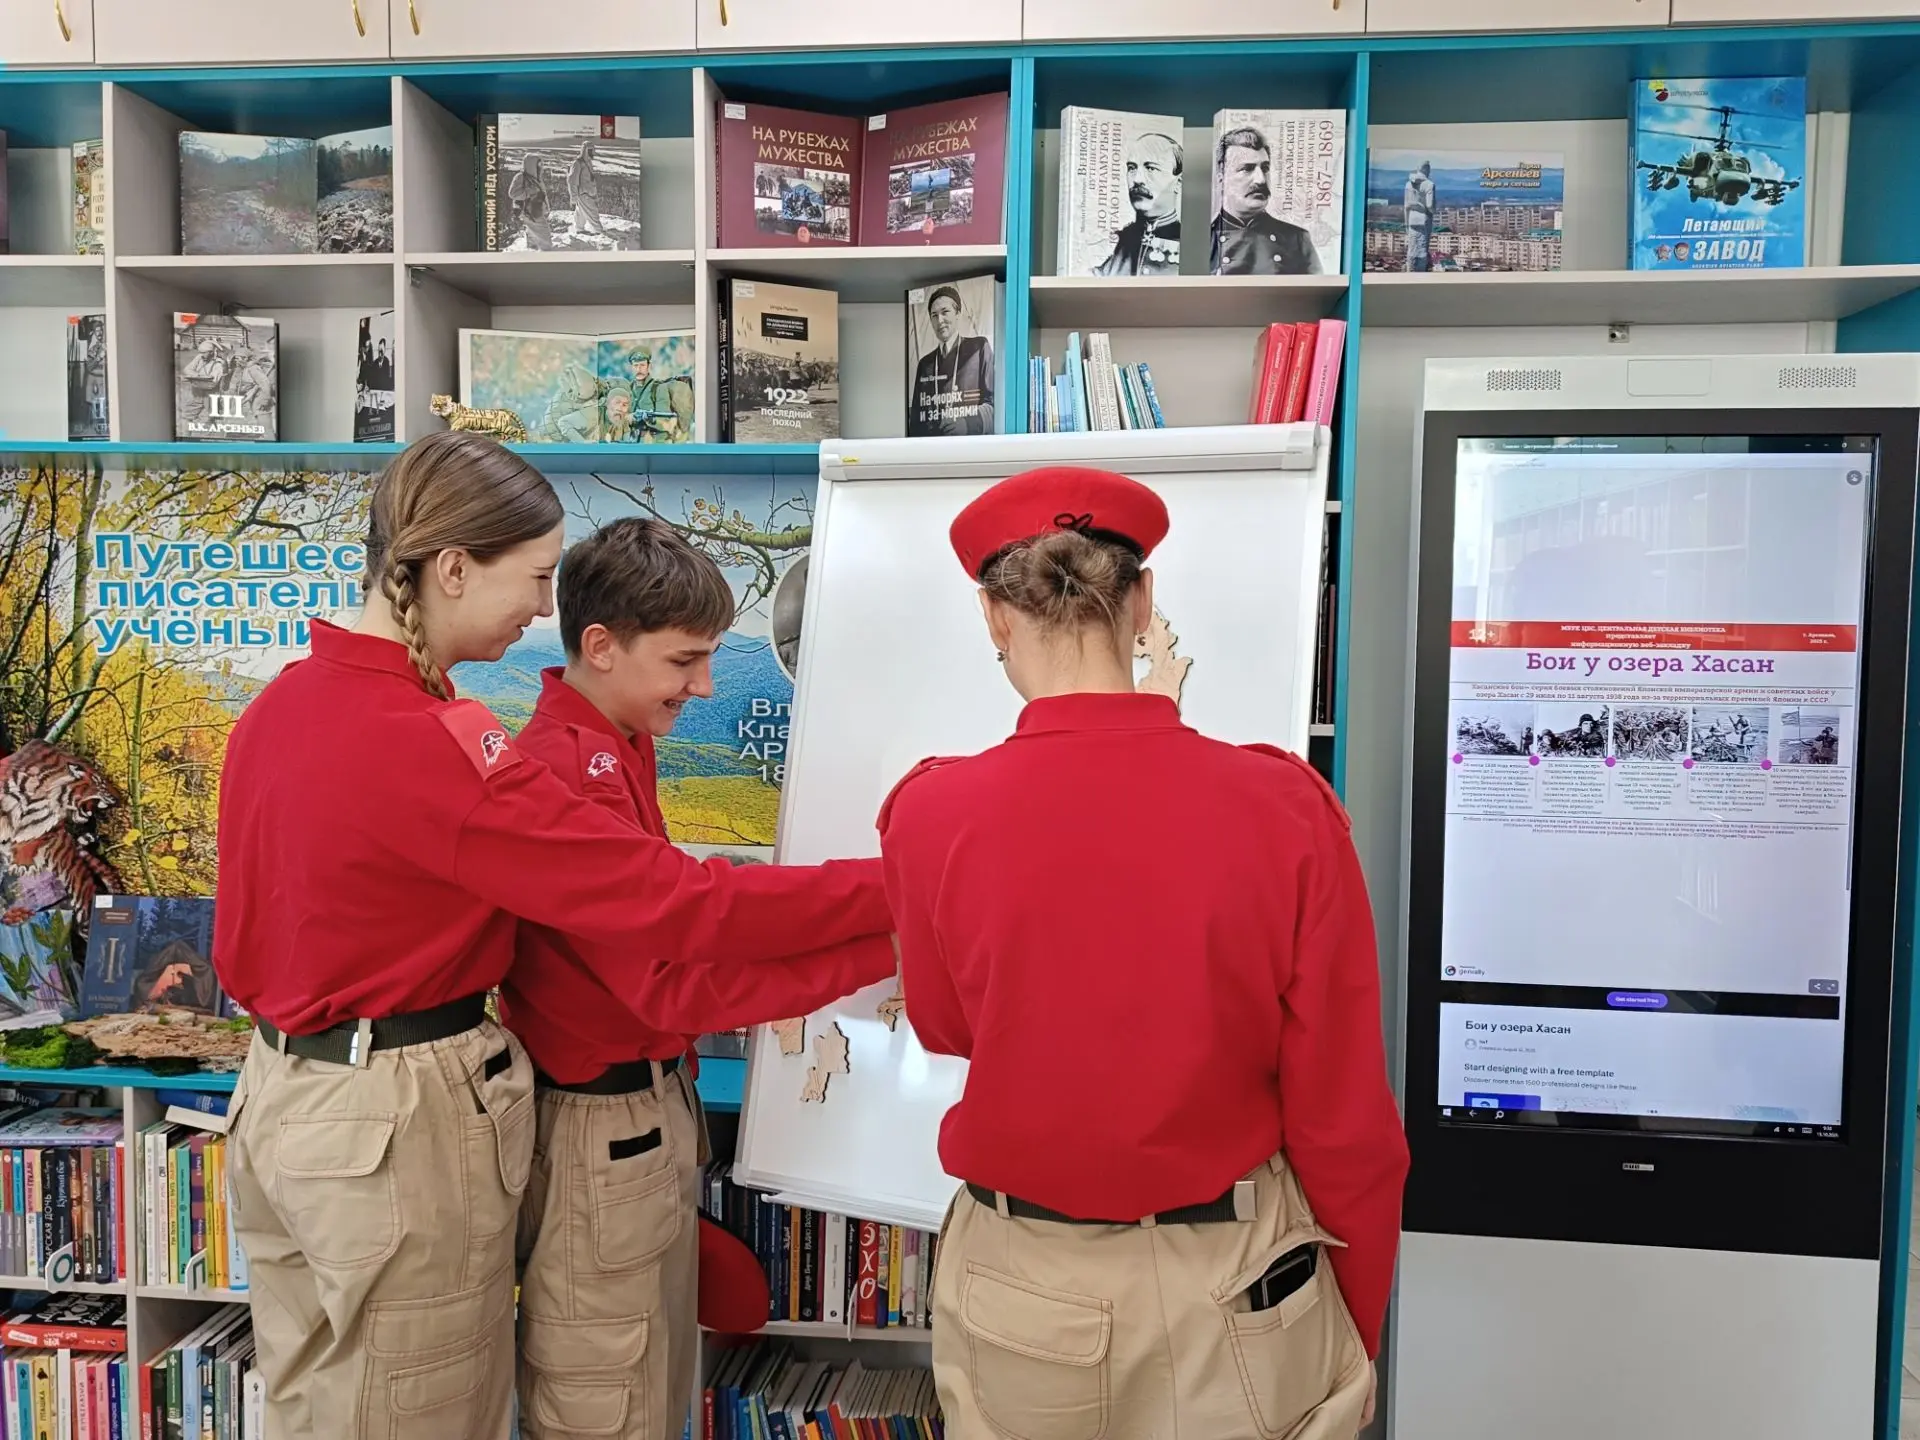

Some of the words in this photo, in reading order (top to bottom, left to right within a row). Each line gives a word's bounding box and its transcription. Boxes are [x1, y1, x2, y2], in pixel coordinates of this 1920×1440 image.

[486, 125, 497, 171] УССУРИ
[752, 126, 775, 142] НА
[779, 129, 850, 152] РУБЕЖАХ
[893, 136, 971, 161] МУЖЕСТВА
[758, 143, 845, 168] МУЖЕСТВА
[1112, 122, 1122, 181] ЯПОНИИ
[1481, 167, 1540, 179] Арсеньев
[484, 173, 497, 198] ЛЁД
[484, 199, 497, 251] ГОРЯЧИЙ
[1097, 210, 1108, 229] ПО
[1682, 217, 1765, 233] Летающий
[1692, 240, 1766, 262] ЗАВОД
[208, 394, 245, 418] III
[764, 386, 810, 406] 1922
[920, 392, 931, 407] На
[933, 390, 963, 408] морях
[760, 407, 813, 420] ПОСЛЕДНИЙ
[772, 418, 802, 429] ПОХОД
[919, 411, 926, 422] и
[927, 409, 939, 421] за
[941, 405, 978, 422] морями
[209, 423, 265, 434] АРСЕНЬЕВ
[95, 533, 364, 578] Путешес
[1526, 652, 1576, 670] Бои
[1584, 656, 1600, 677] у
[1608, 657, 1684, 677] озера
[1692, 655, 1775, 673] Хасан
[738, 742, 785, 760] АР
[1465, 1020, 1488, 1031] Бои
[1491, 1023, 1497, 1033] у
[1500, 1024, 1533, 1033] озера
[1535, 1023, 1571, 1034] Хасан
[1464, 1063, 1486, 1072] Start
[1486, 1064, 1528, 1075] designing
[1529, 1065, 1549, 1075] with
[1557, 1066, 1575, 1076] free
[1576, 1068, 1615, 1079] template
[1463, 1076, 1491, 1084] Discover
[1509, 1078, 1524, 1086] than
[1541, 1079, 1580, 1089] professional
[1581, 1082, 1606, 1091] designs
[44, 1193, 54, 1220] ДОЧЬ
[44, 1222, 53, 1262] АРСКАЯ
[38, 1390, 47, 1421] ПТАШКА
